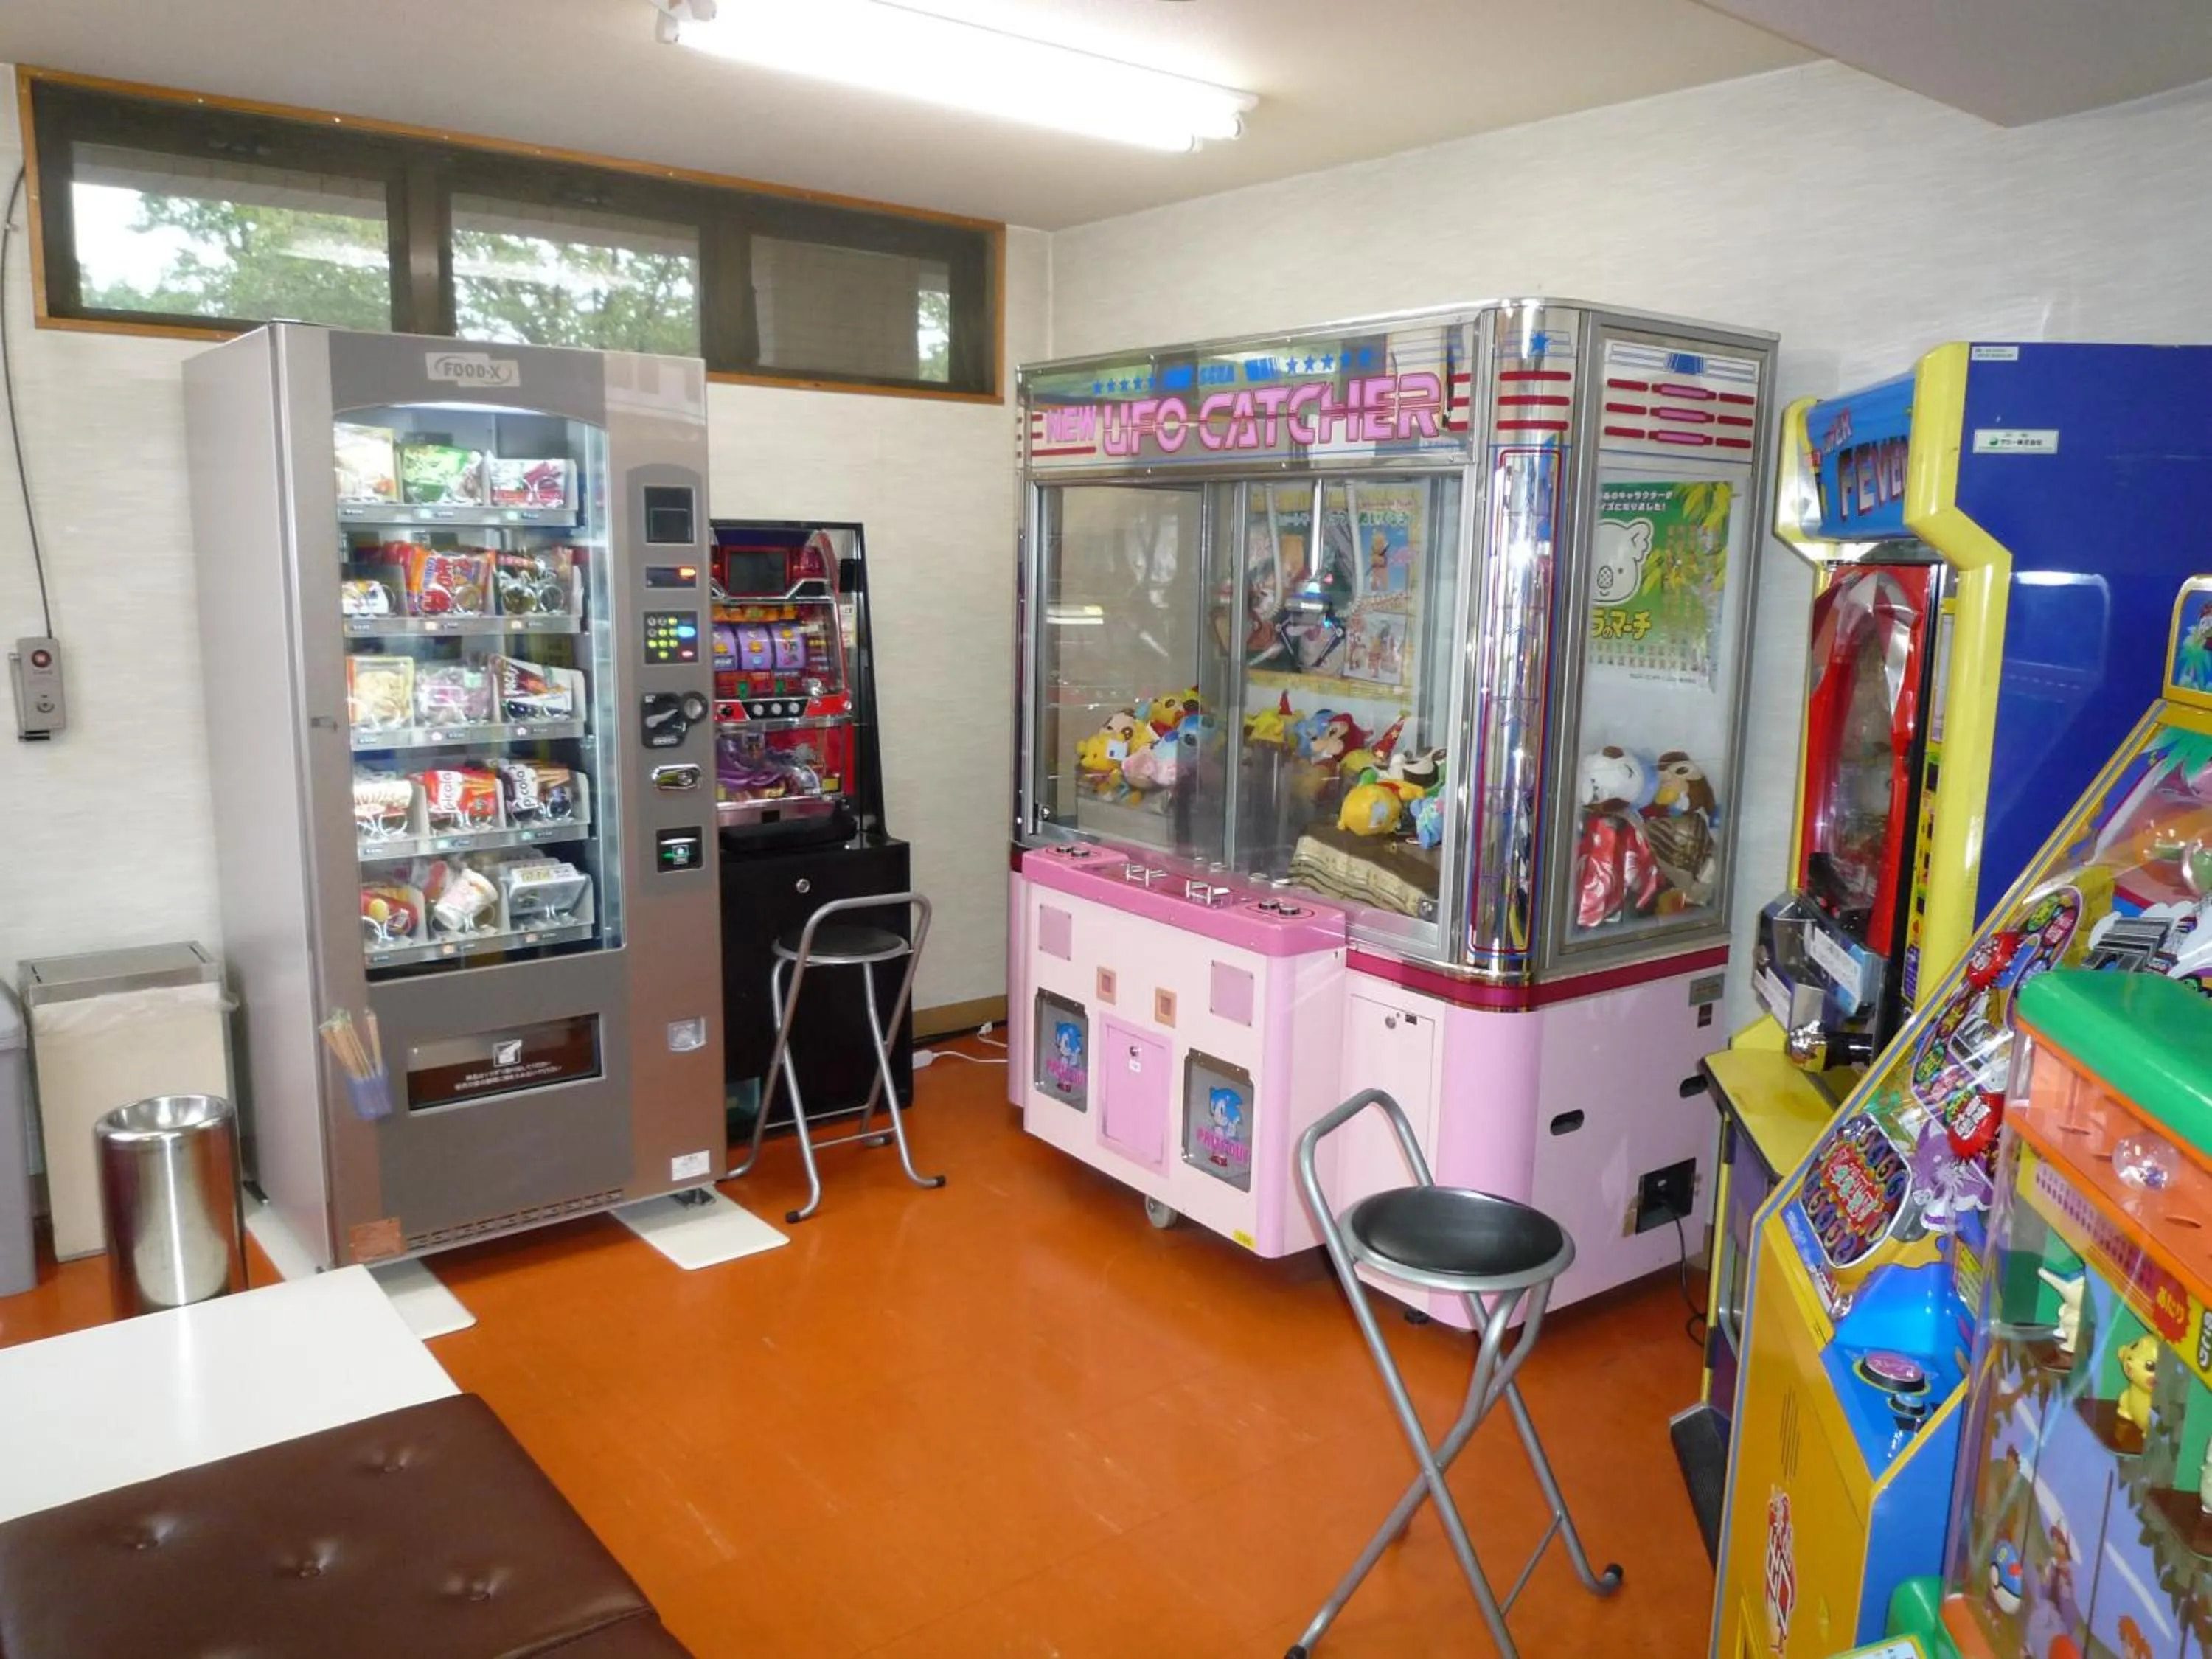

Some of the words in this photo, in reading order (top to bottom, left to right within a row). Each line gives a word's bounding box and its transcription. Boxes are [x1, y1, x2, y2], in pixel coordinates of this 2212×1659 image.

[1047, 405, 1096, 443] NEW
[1103, 397, 1188, 455] UFO
[1199, 372, 1440, 450] CATCHER
